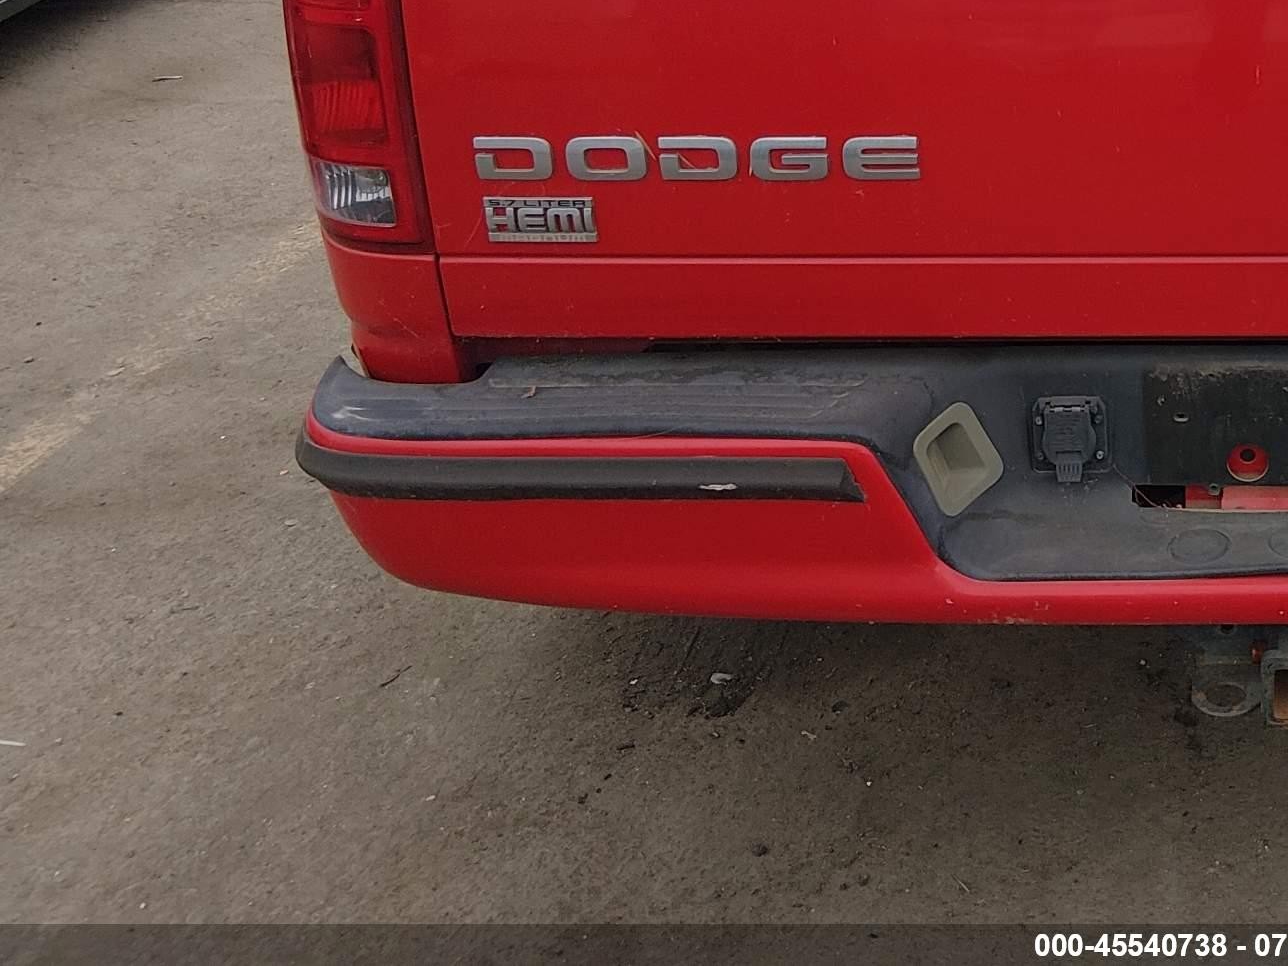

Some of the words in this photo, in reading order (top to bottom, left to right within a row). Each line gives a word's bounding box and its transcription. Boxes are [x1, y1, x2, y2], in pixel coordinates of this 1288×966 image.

[473, 135, 921, 181] DODGE
[523, 199, 587, 208] LITER
[484, 207, 597, 233] HEMI
